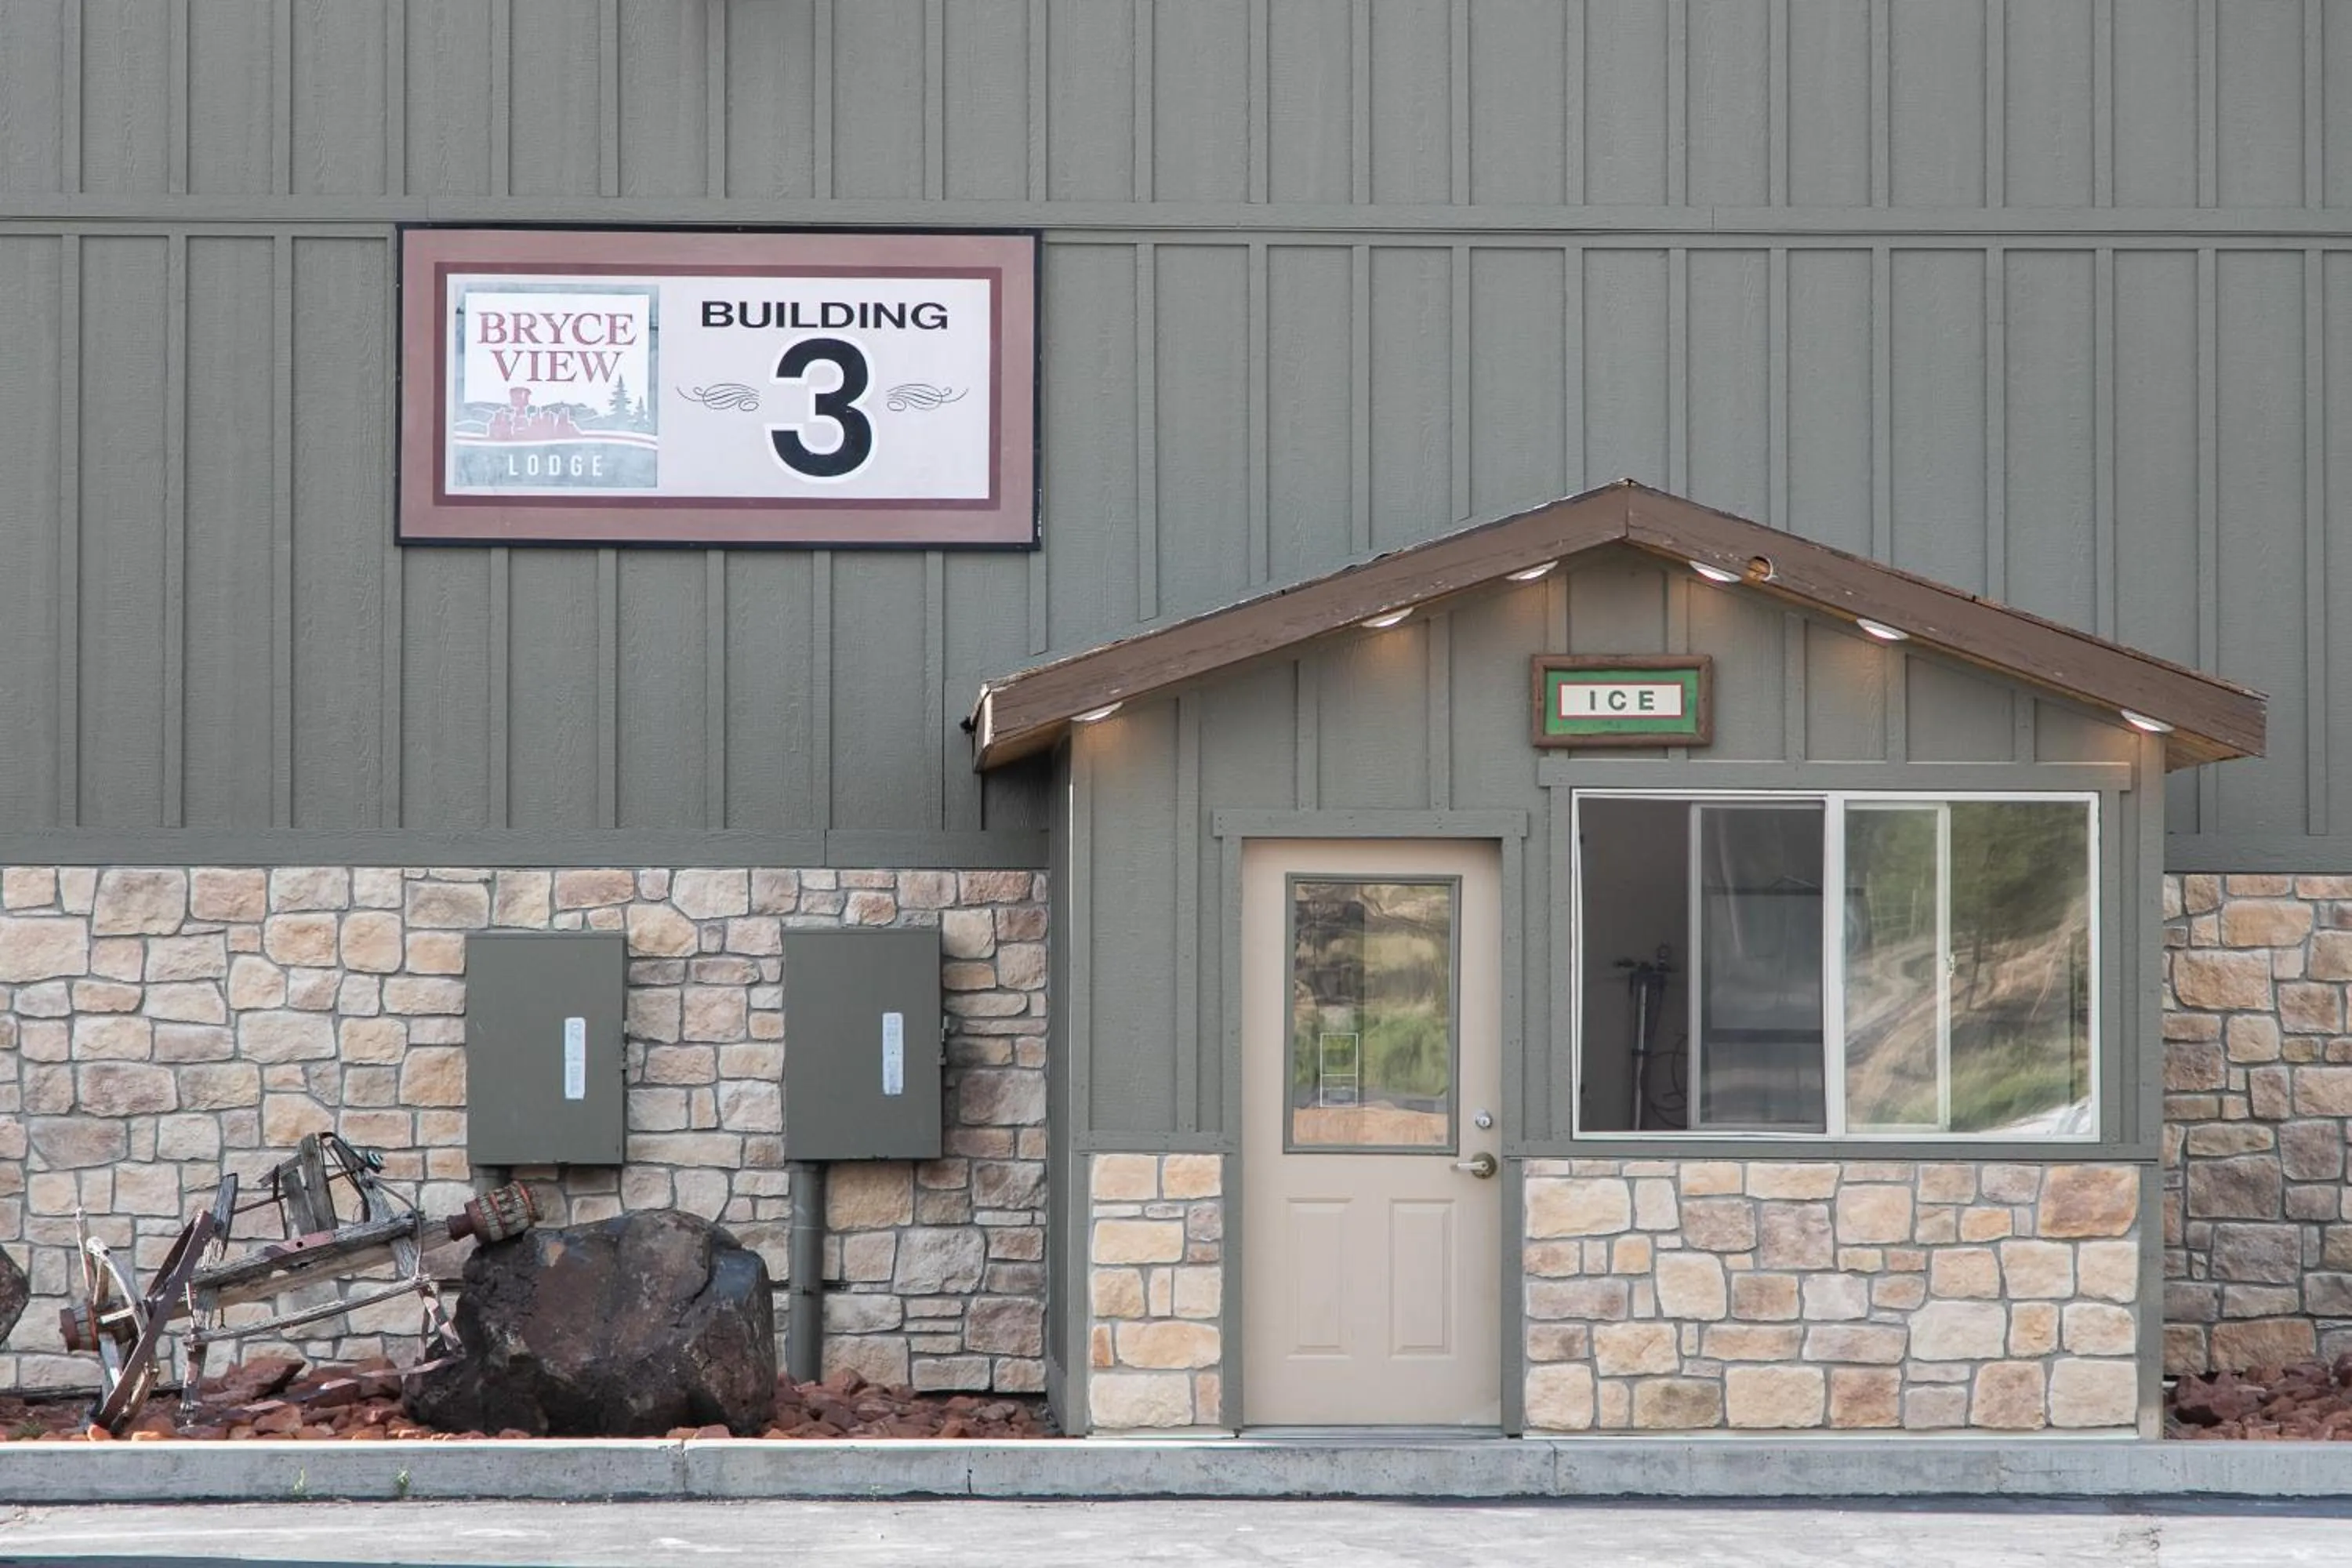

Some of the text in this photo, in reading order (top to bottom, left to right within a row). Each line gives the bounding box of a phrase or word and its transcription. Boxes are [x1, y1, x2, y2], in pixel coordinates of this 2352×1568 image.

[477, 312, 637, 346] BRYCE
[702, 300, 948, 329] BUILDING
[491, 350, 622, 383] VIEW
[771, 338, 873, 477] 3
[507, 453, 604, 477] LODGE
[1589, 690, 1654, 710] ICE
